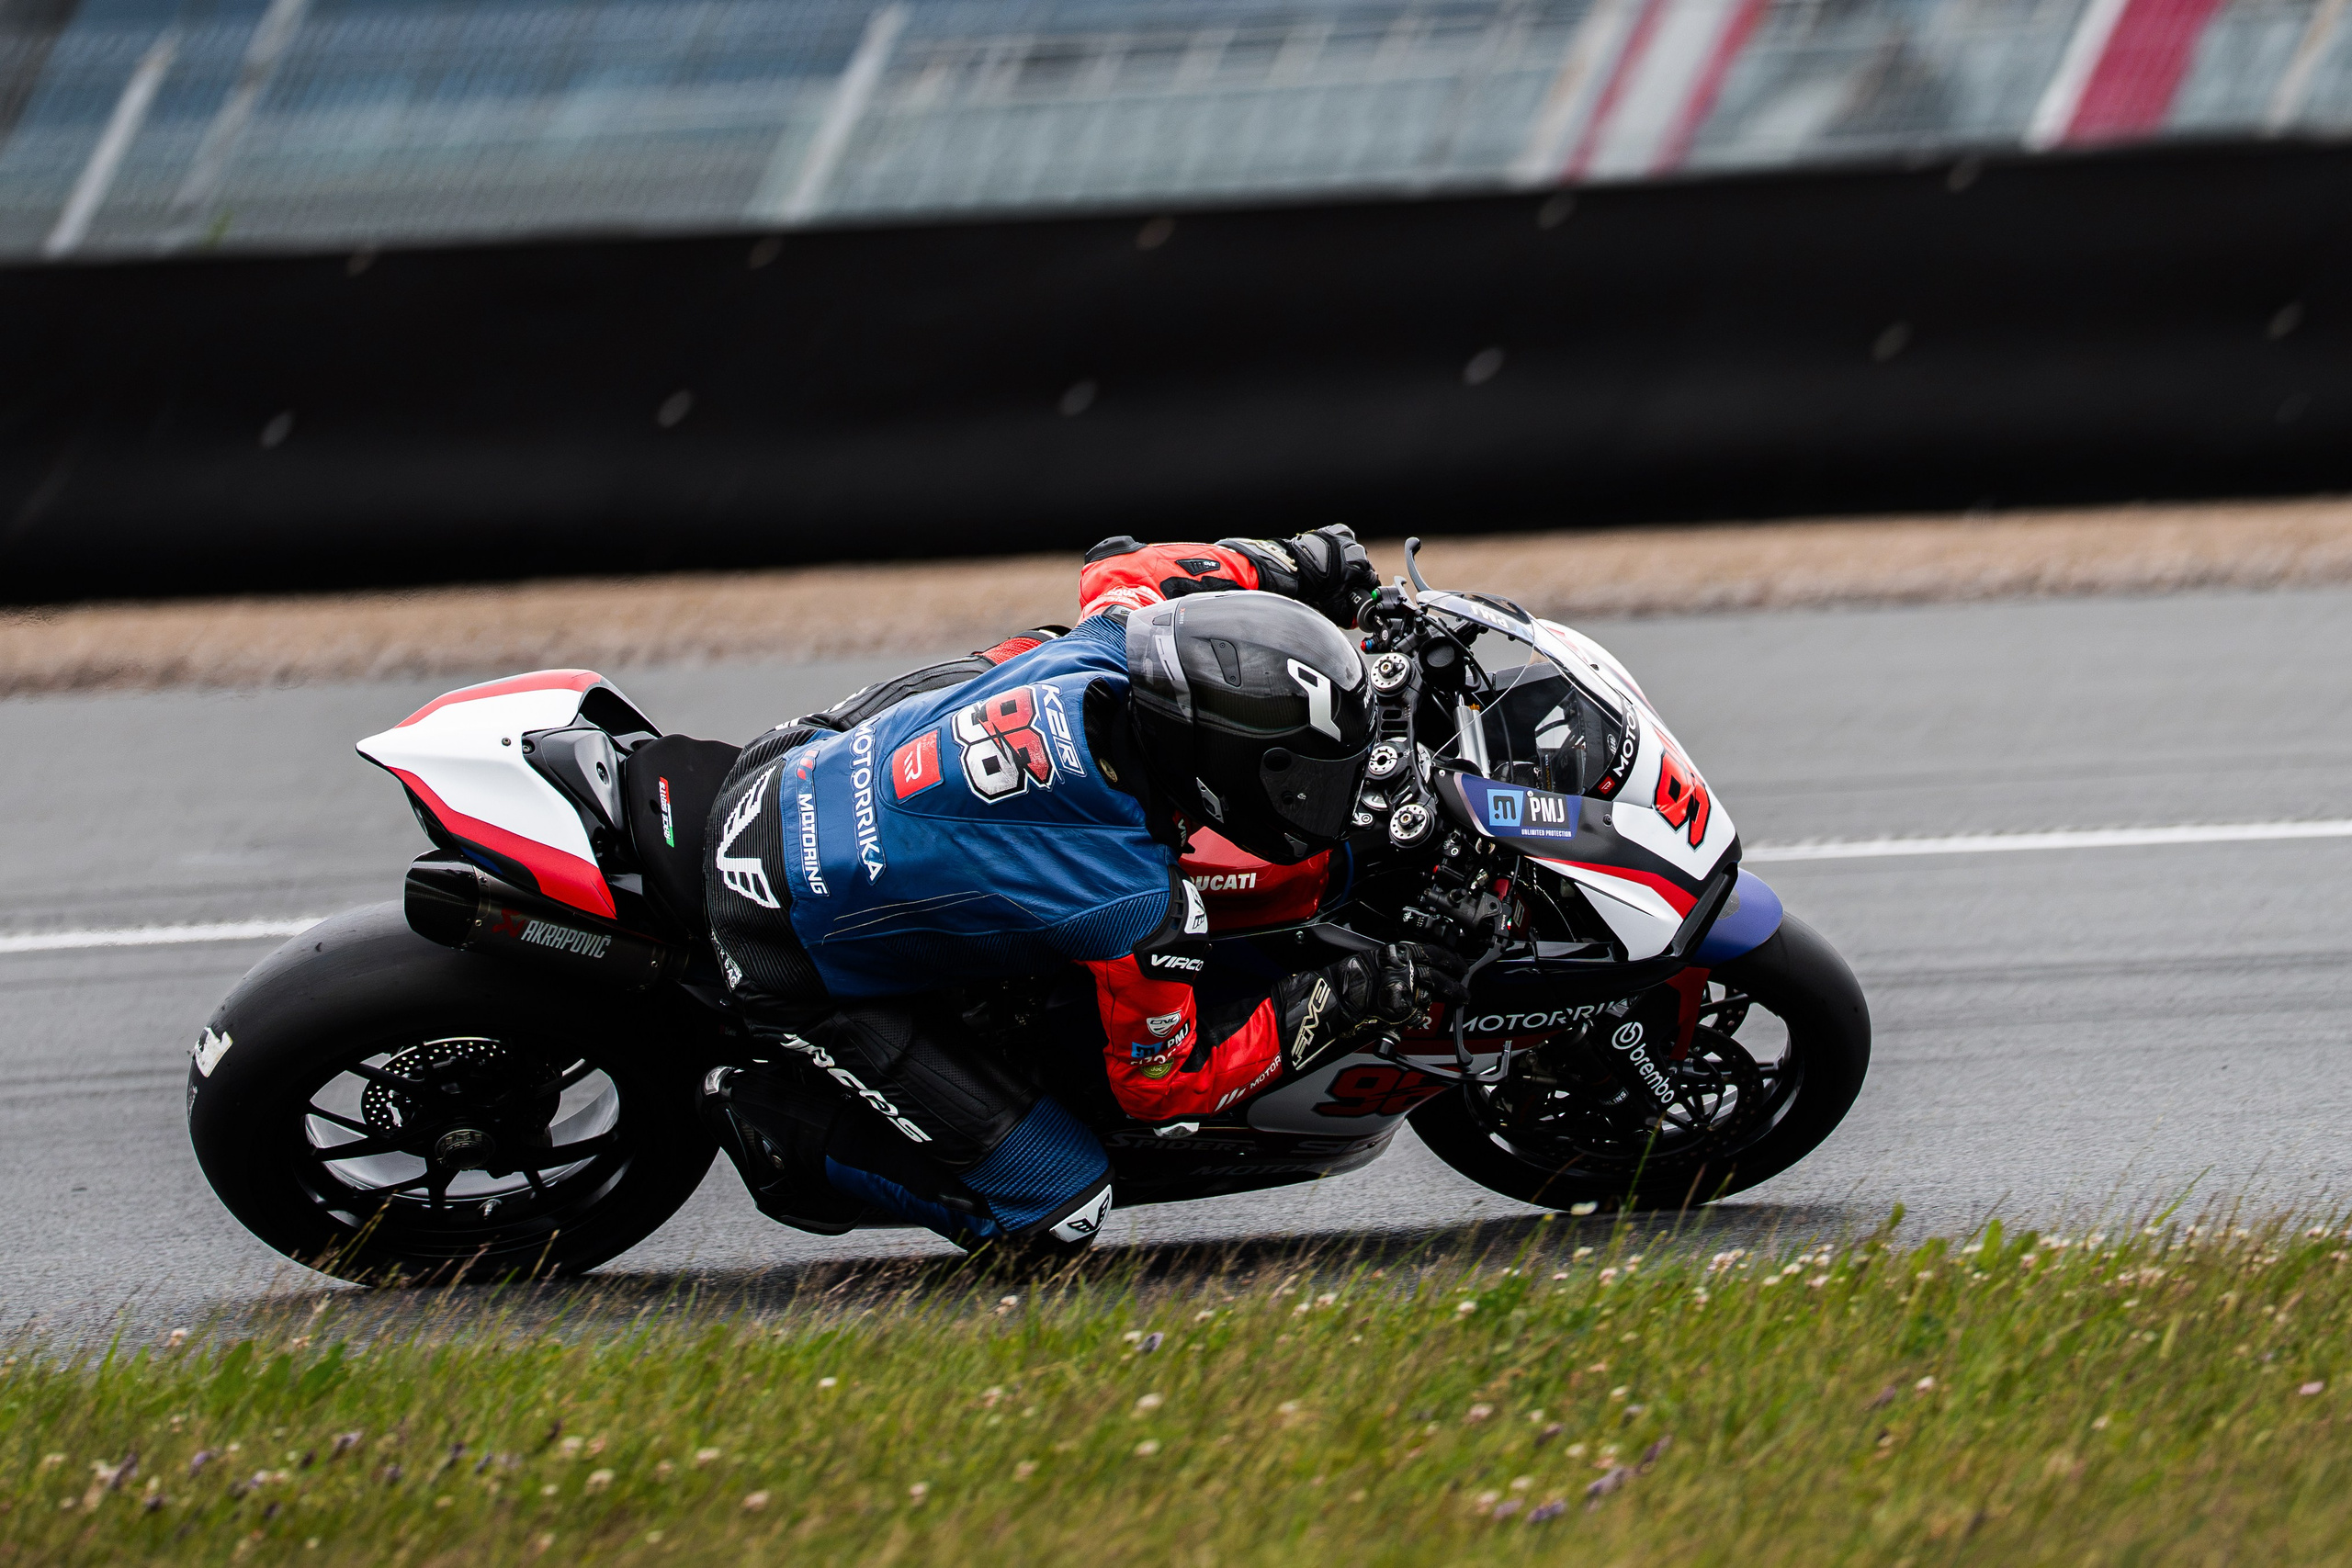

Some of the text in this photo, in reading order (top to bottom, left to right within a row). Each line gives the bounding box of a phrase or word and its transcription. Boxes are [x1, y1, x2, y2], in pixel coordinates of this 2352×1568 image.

[951, 685, 1057, 805] 96
[1529, 796, 1566, 823] PMJ
[798, 794, 829, 896] MOTORING
[1521, 829, 1572, 838] UNLIMITED PROTECTION
[1189, 873, 1257, 891] UCATI
[1168, 1023, 1189, 1049] PMJ
[1629, 1043, 1675, 1104] brembo
